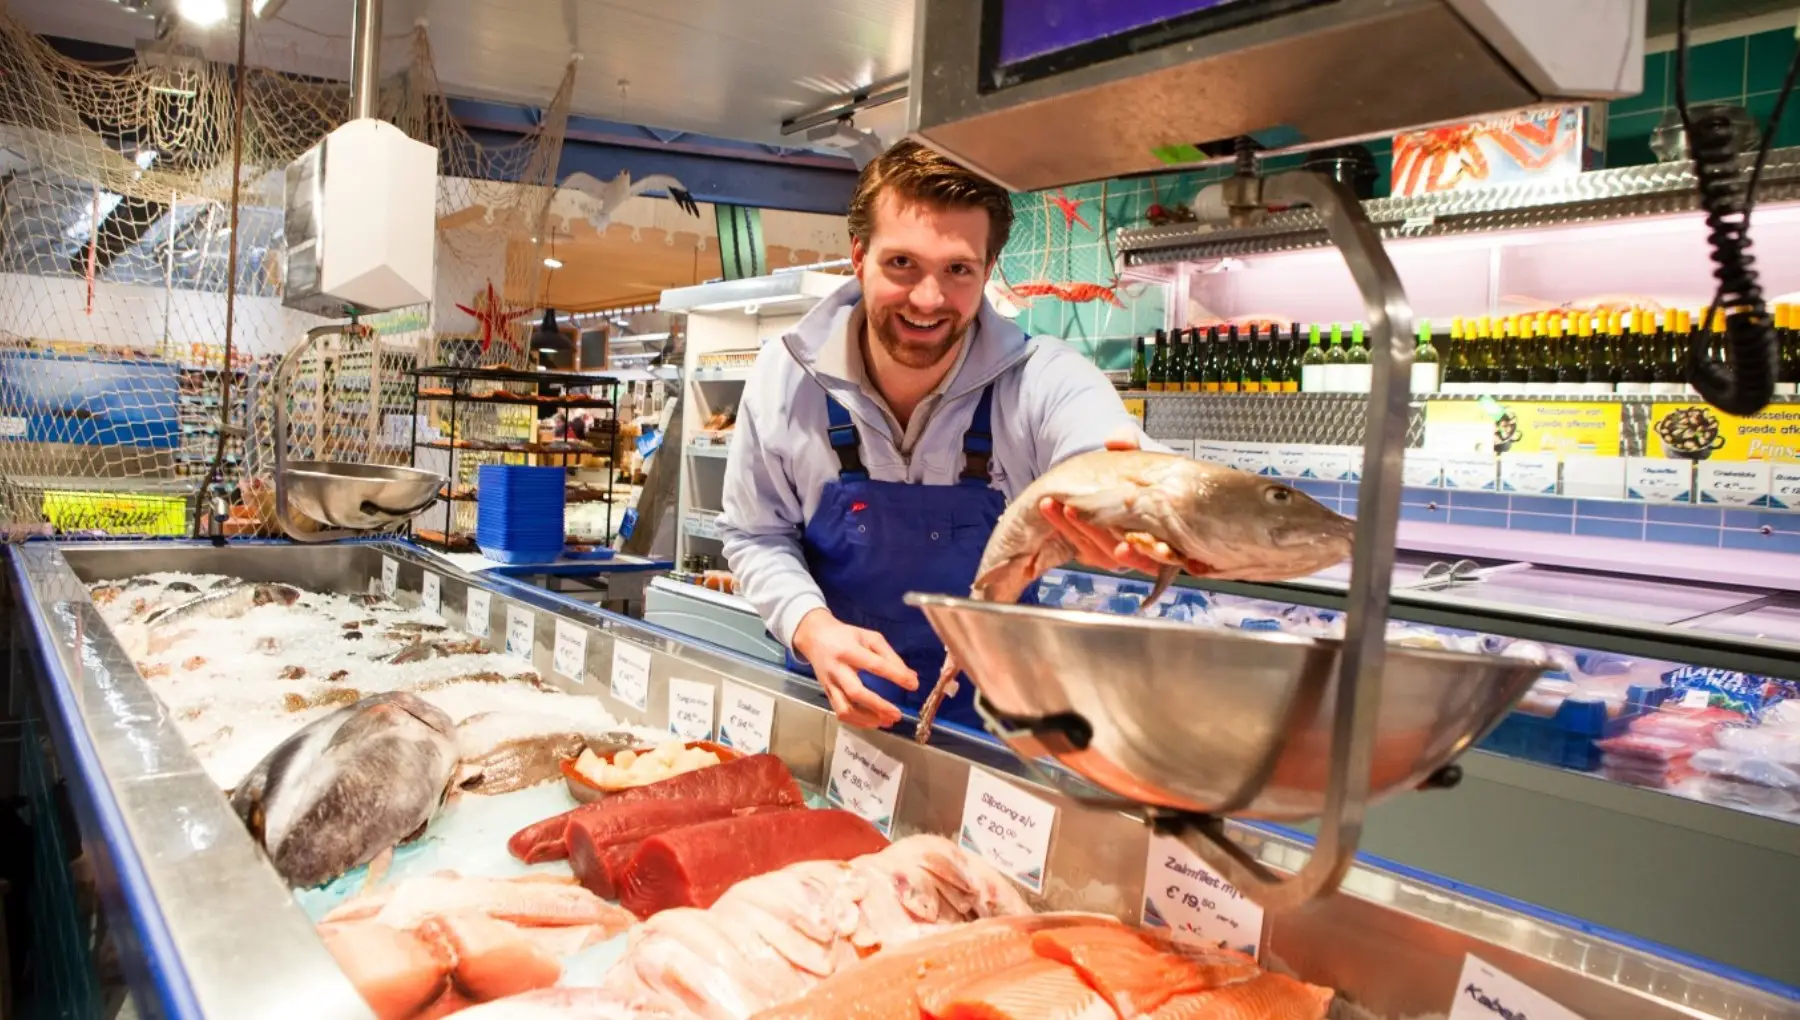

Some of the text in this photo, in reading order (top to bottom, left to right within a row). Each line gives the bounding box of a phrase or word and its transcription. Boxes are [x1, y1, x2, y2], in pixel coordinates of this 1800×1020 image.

[1738, 424, 1777, 435] goede
[981, 791, 1019, 821] Sliptong
[976, 813, 988, 827] €
[1164, 856, 1220, 889] Zalmfilet
[1165, 885, 1180, 899] €
